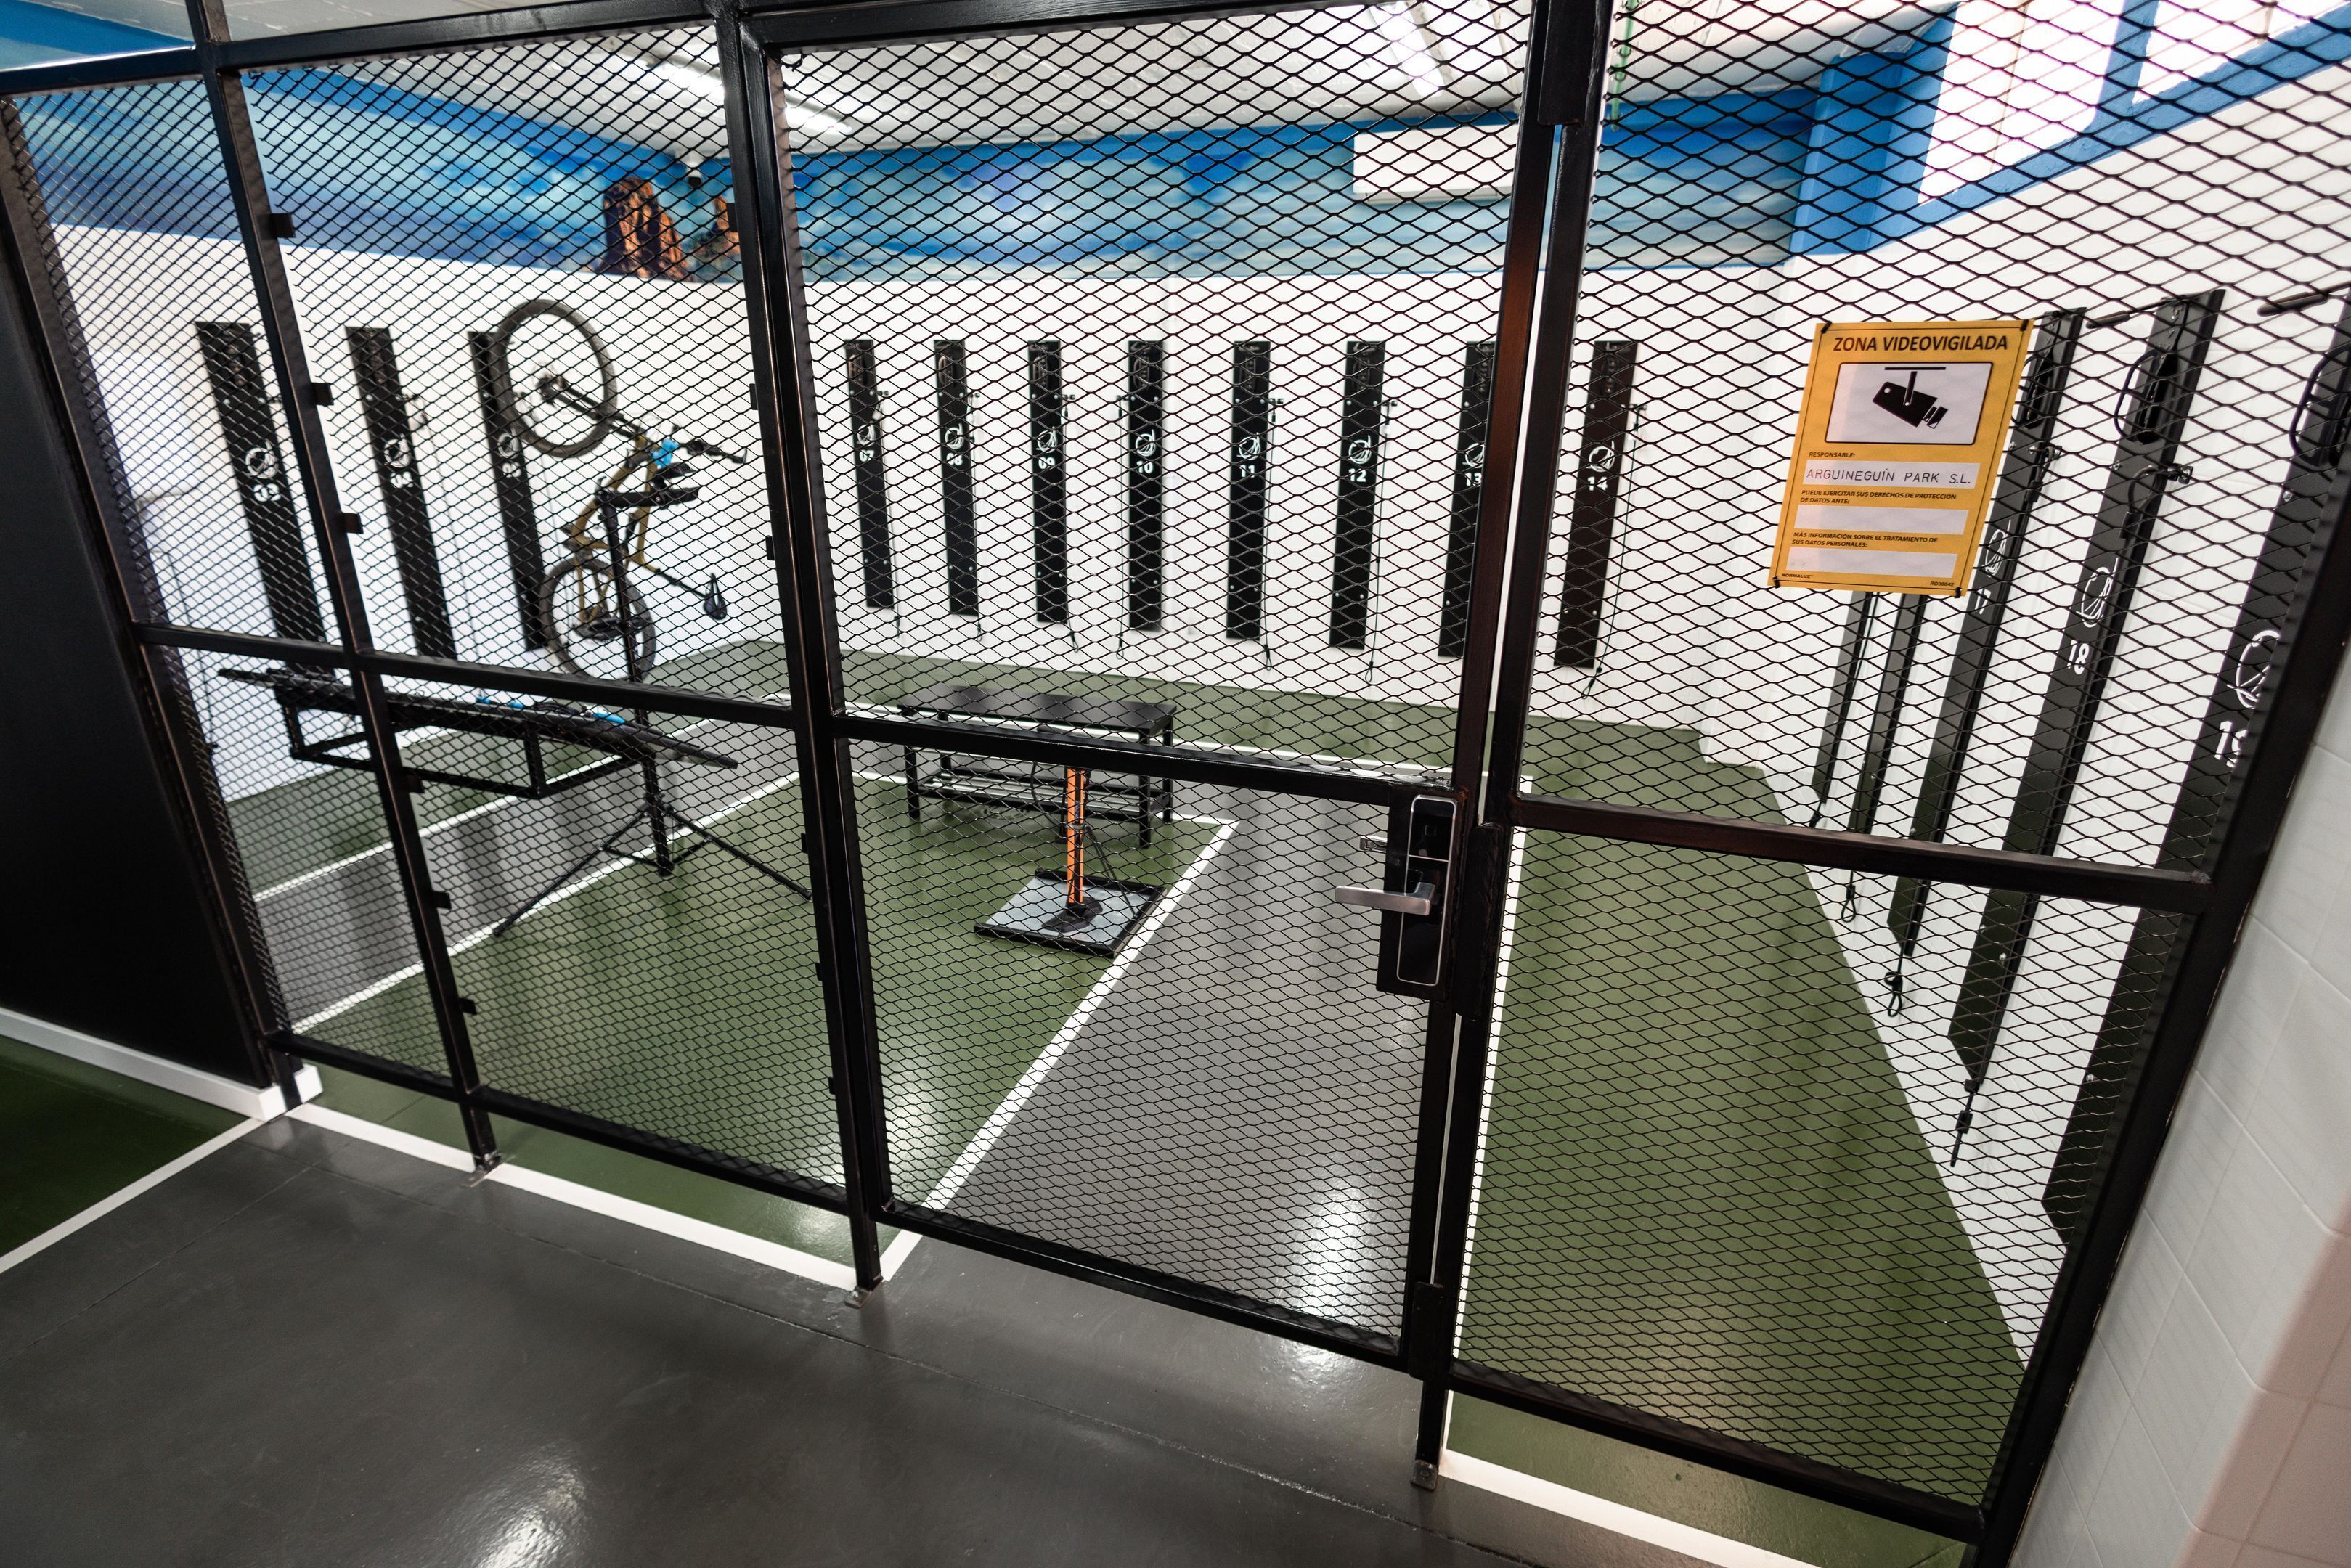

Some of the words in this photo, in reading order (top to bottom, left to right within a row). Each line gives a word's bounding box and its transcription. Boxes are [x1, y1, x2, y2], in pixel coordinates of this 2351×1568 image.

[1833, 336, 1877, 351] ZONA
[1883, 335, 2008, 351] VIDEOVIGILADA
[859, 449, 874, 462] 07
[946, 452, 963, 466] 08
[1038, 456, 1055, 470] 09
[1136, 460, 1154, 474] 10
[1240, 464, 1256, 478] 11
[1348, 468, 1366, 482] 12
[1806, 468, 1895, 482] ARGUINEGUÍN
[1904, 472, 1939, 483] PARK
[1949, 473, 1971, 484] S.L.
[1466, 473, 1482, 487] 13
[1587, 476, 1608, 491] 14
[253, 483, 282, 502] 03
[1974, 587, 1992, 615] 17
[2067, 639, 2090, 675] 18
